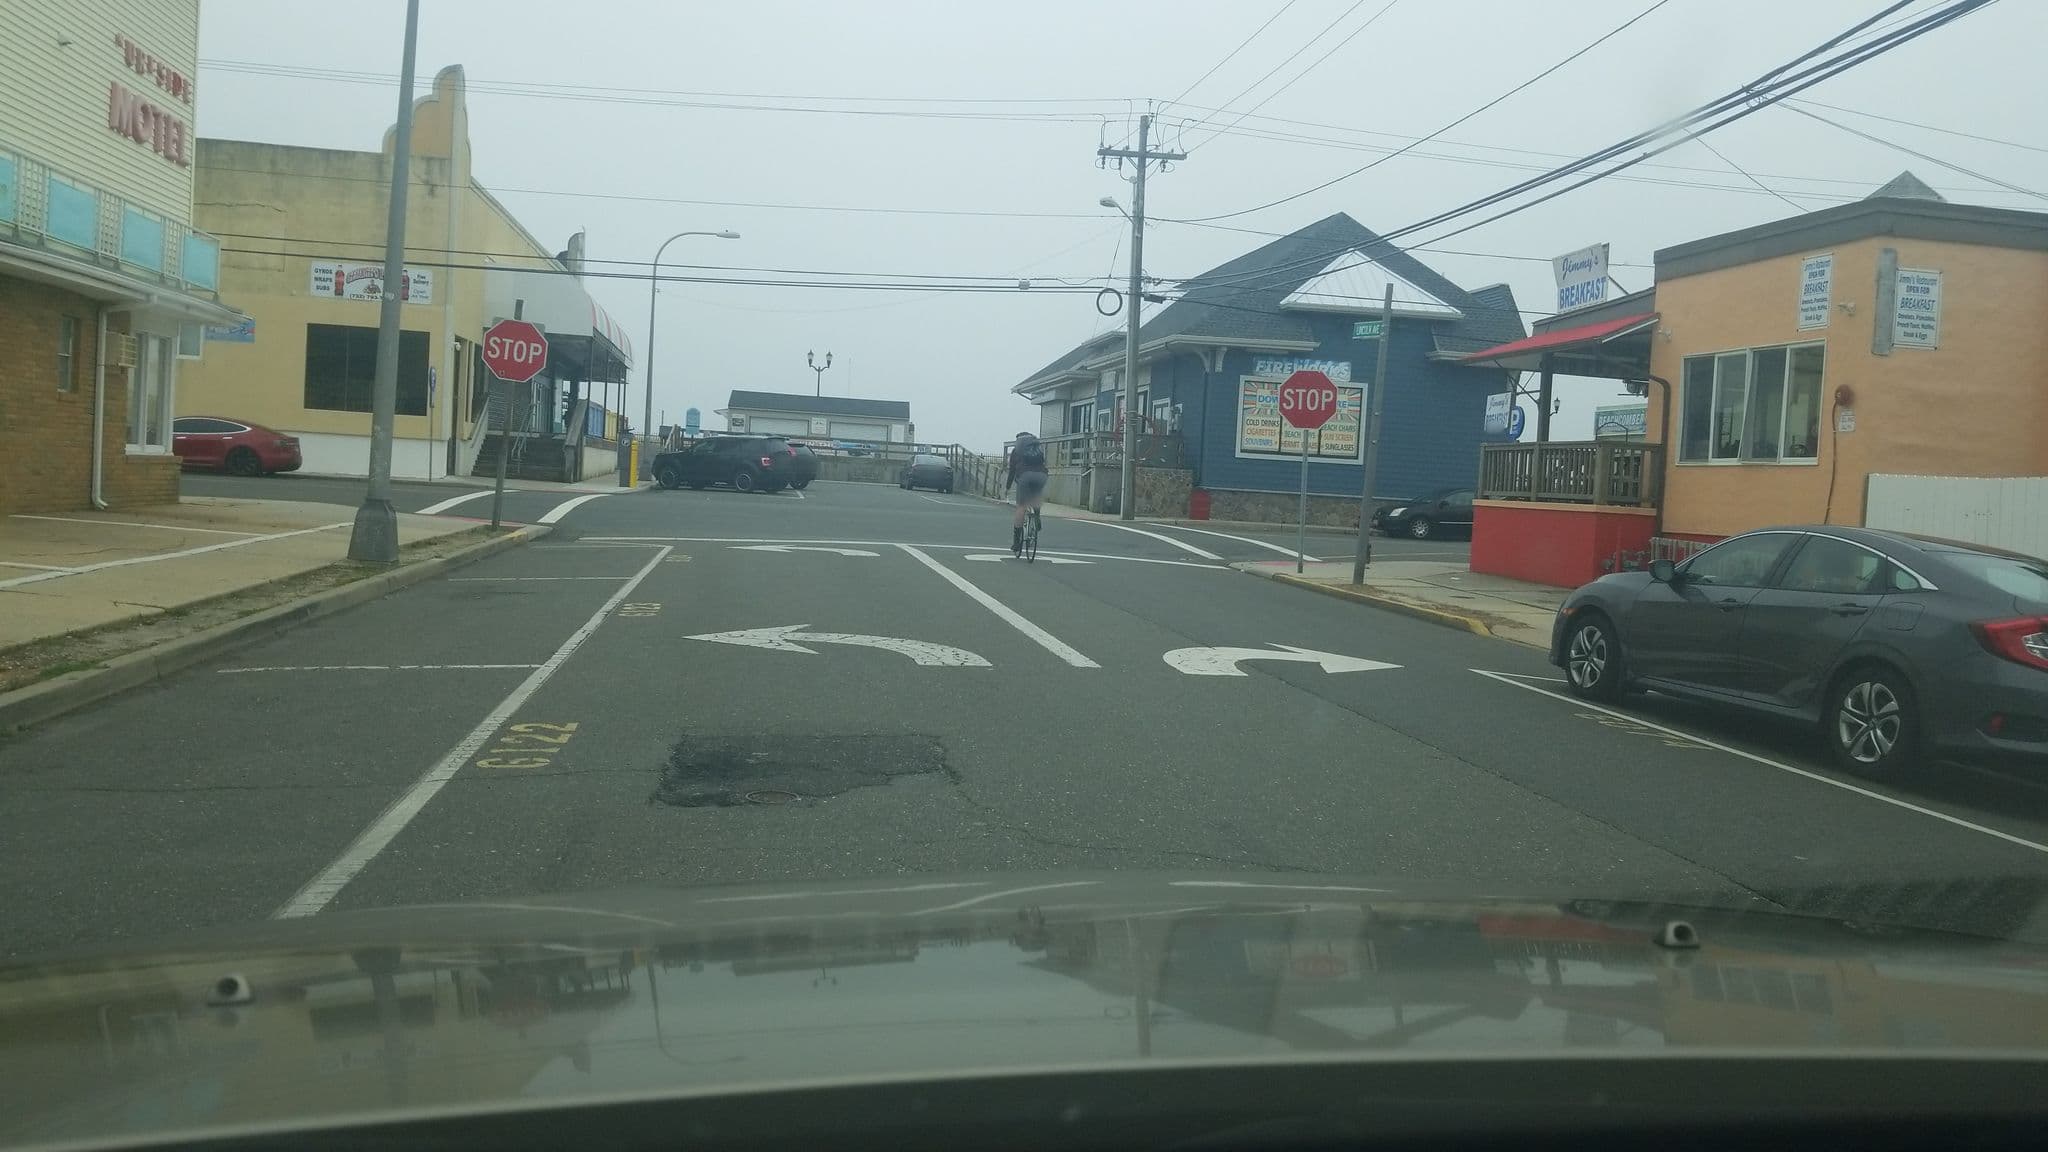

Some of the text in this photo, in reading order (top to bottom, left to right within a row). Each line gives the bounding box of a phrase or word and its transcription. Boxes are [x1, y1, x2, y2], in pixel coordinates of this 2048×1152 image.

[109, 81, 188, 168] MOTEL
[1562, 249, 1599, 280] Jimmy's
[1560, 276, 1606, 309] BREAKFAST
[1900, 297, 1936, 311] BREAKFAST
[487, 336, 543, 364] STOP
[1282, 388, 1334, 411] STOP
[1246, 418, 1280, 428] COLD DRINKS
[1246, 428, 1276, 438] CIGARETTES
[1244, 438, 1273, 447] SOUVENIRS
[1325, 443, 1355, 452] SUNGLASSES
